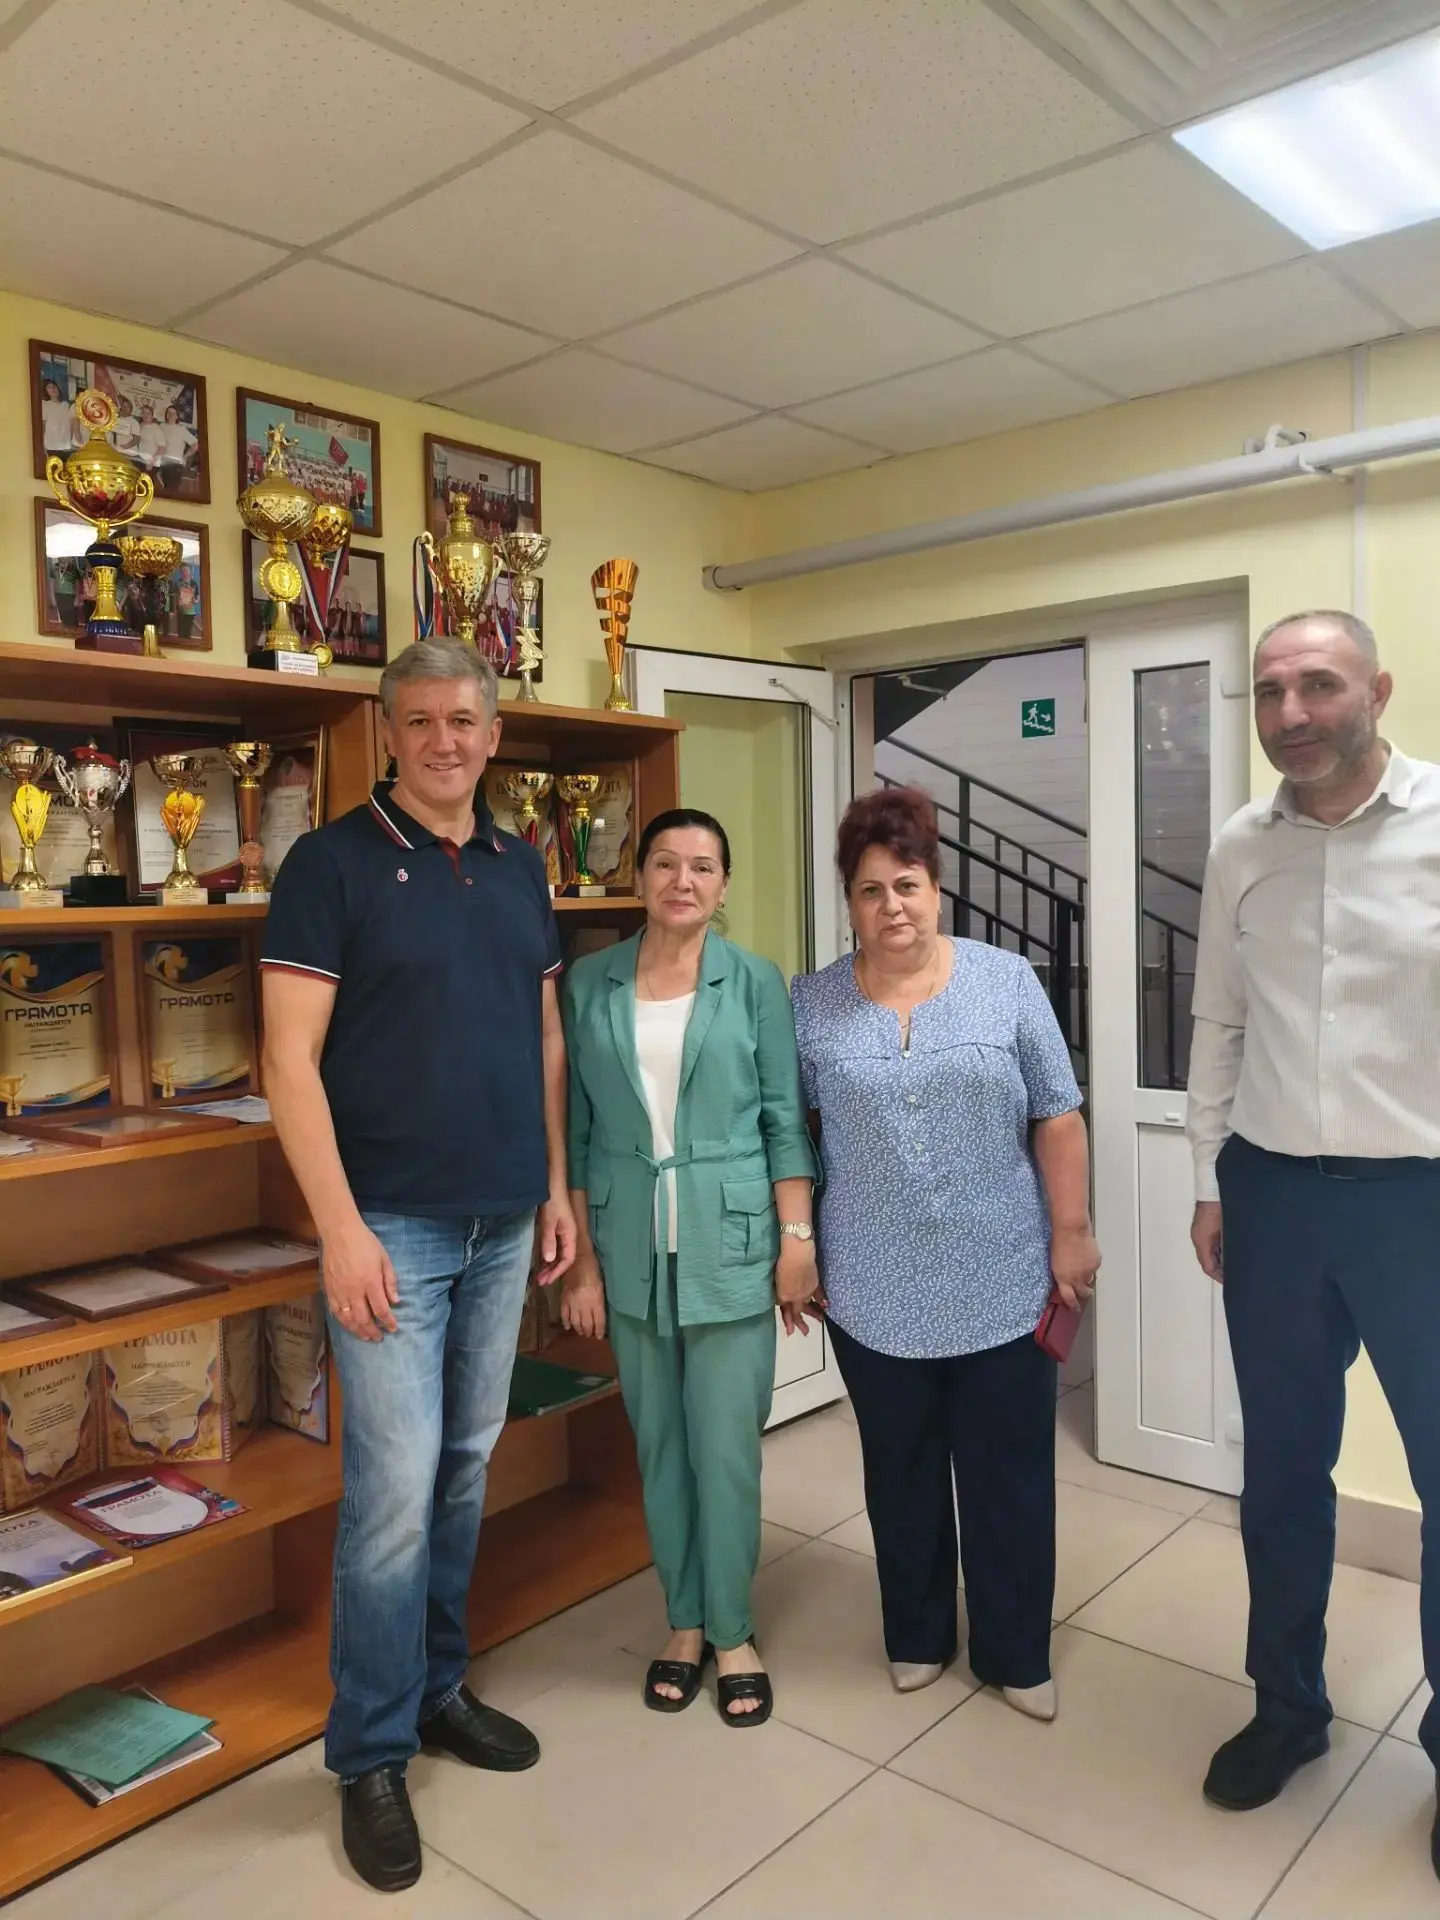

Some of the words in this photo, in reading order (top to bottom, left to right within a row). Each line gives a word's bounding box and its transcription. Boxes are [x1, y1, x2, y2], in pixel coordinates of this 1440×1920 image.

[158, 992, 235, 1011] ГРАМОТА
[4, 1002, 93, 1022] ГРАМОТА
[100, 1490, 164, 1513] ГРАМОТА
